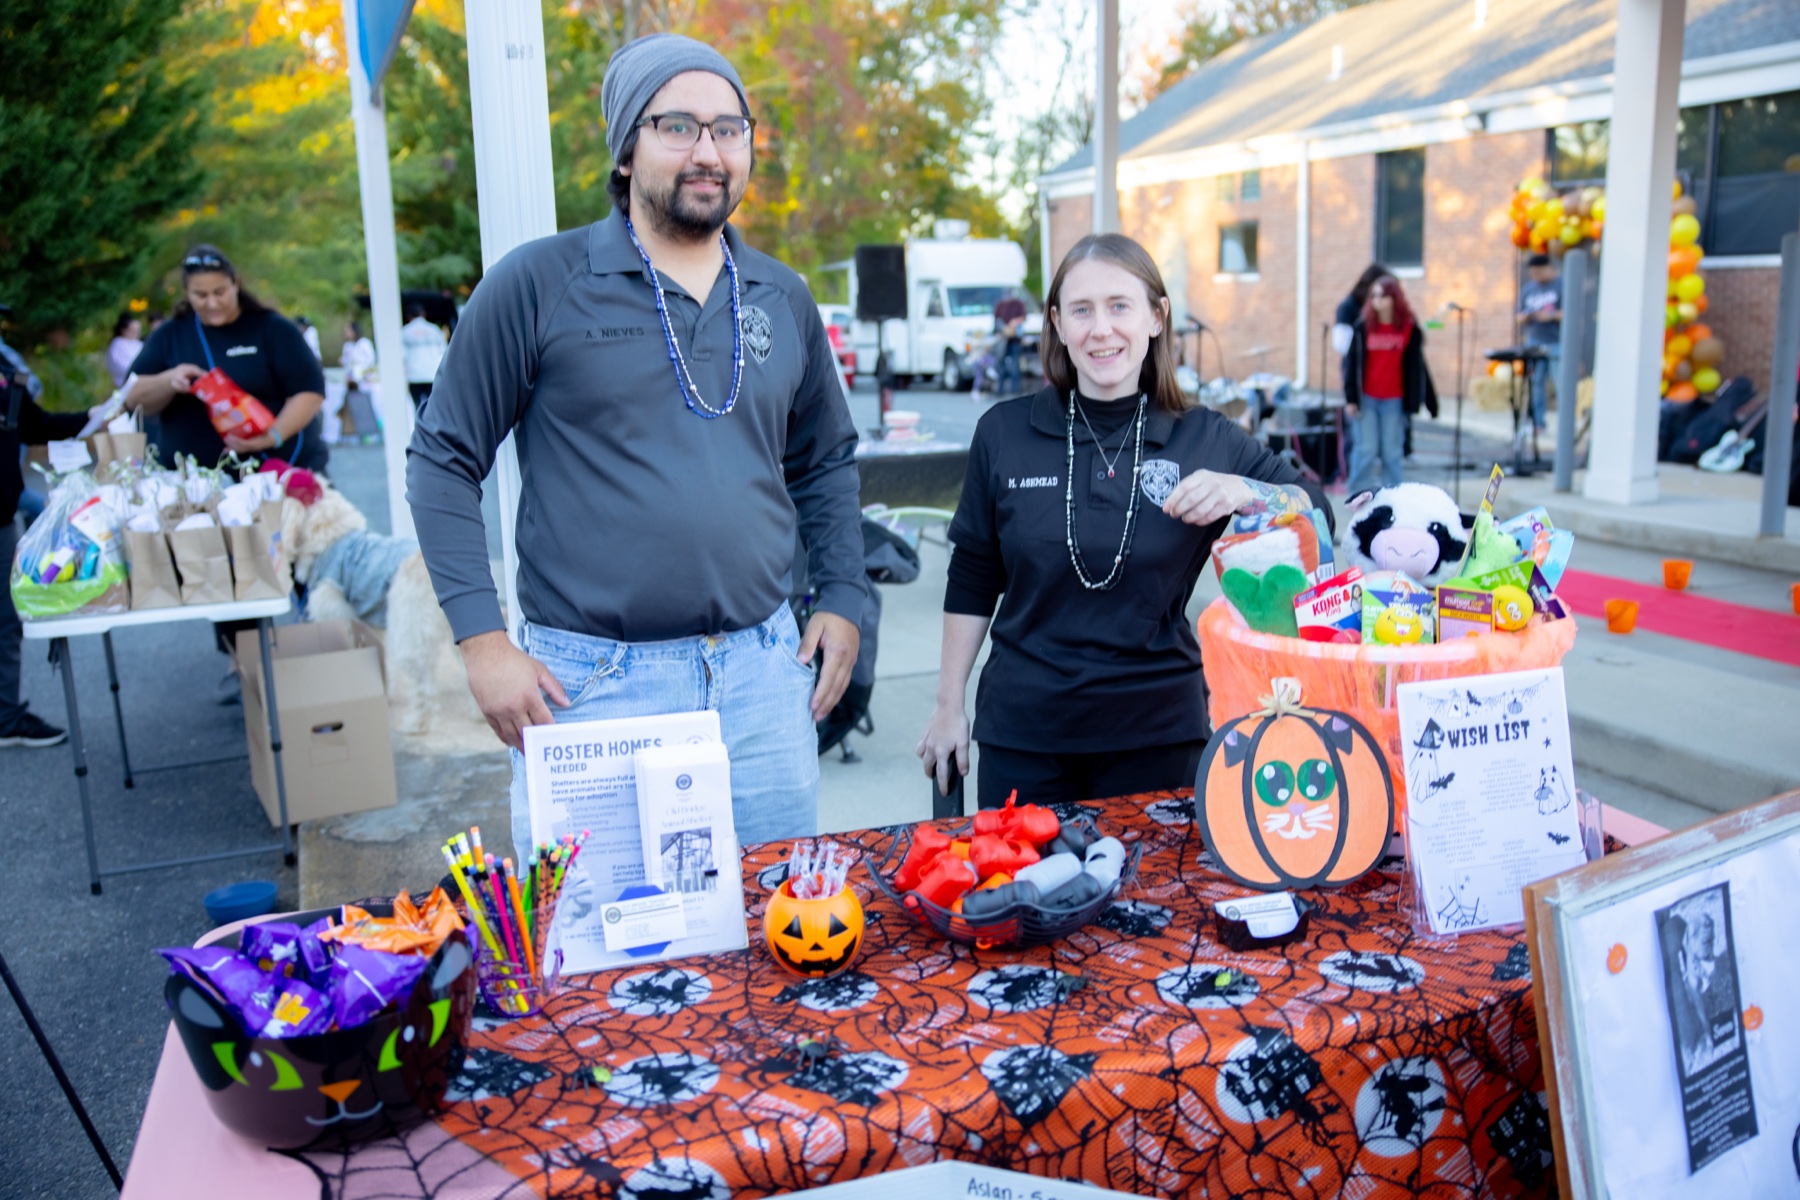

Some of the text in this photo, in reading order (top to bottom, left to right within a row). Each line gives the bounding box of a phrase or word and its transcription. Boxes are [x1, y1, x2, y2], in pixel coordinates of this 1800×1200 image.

[585, 327, 644, 340] A. NIEVES
[1312, 593, 1342, 616] KONG
[1447, 720, 1530, 749] WISH LIST
[543, 743, 603, 762] FOSTER
[550, 762, 587, 774] NEEDED
[551, 779, 579, 788] Shelters
[592, 776, 616, 785] always
[617, 774, 628, 782] full
[551, 788, 568, 796] have
[569, 786, 596, 795] animals
[597, 784, 611, 792] that
[624, 781, 637, 790] too
[552, 796, 575, 806] young
[586, 792, 618, 802] adoption
[967, 1177, 1012, 1200] Aslan
